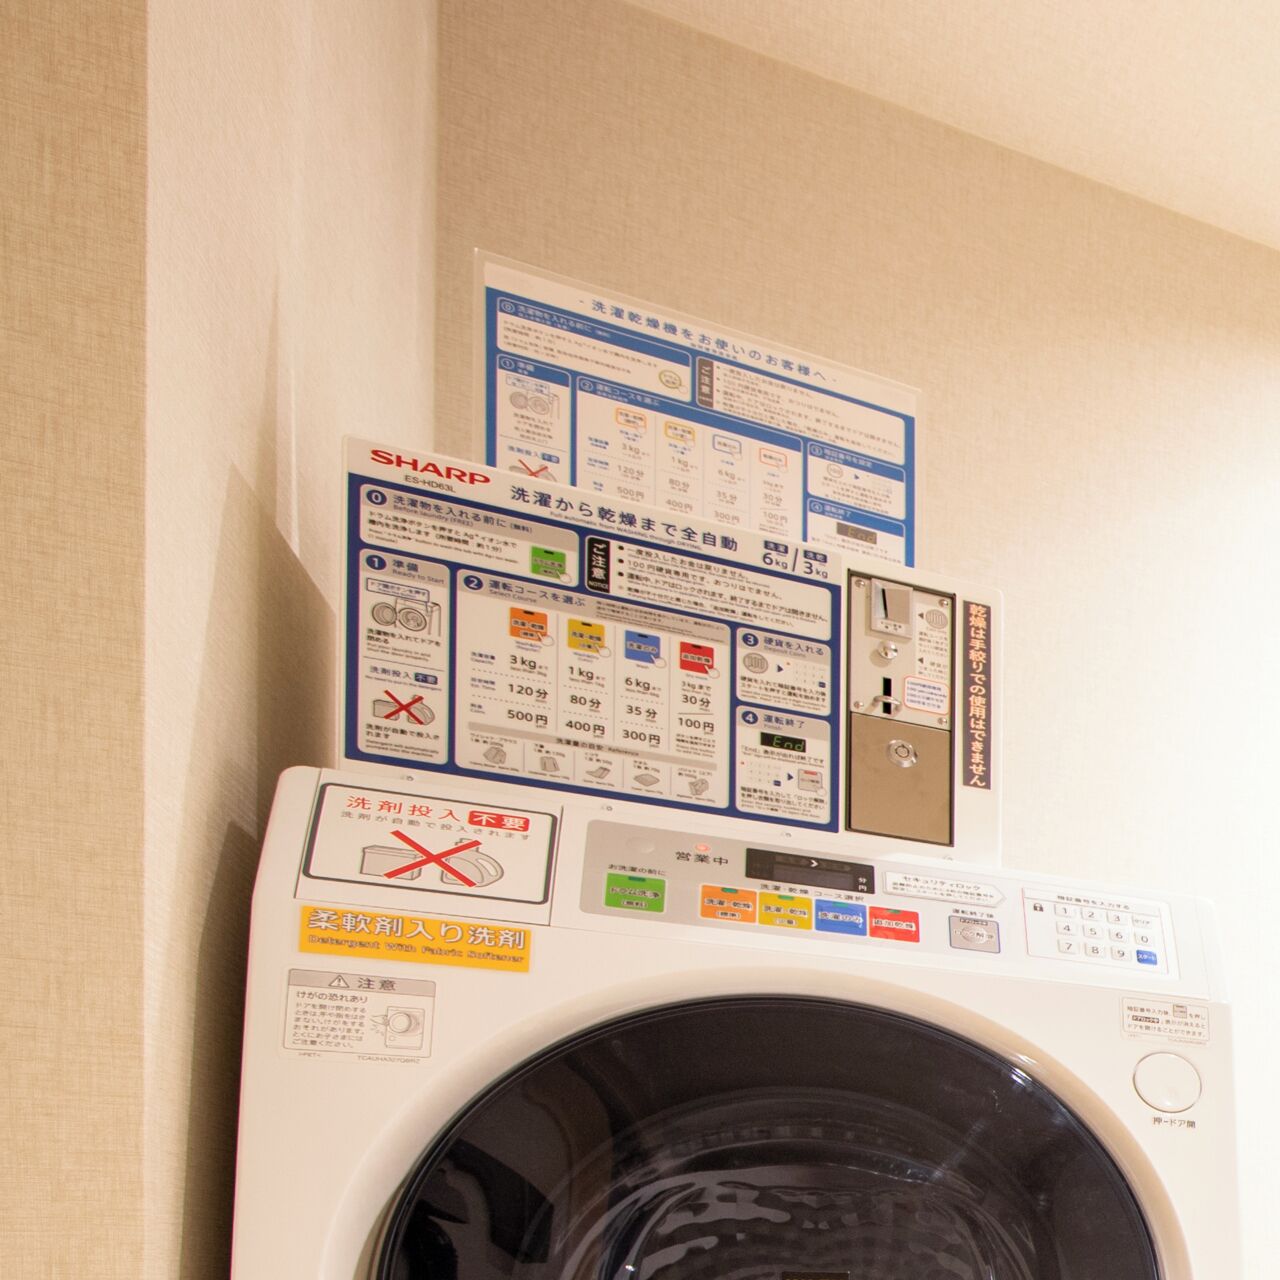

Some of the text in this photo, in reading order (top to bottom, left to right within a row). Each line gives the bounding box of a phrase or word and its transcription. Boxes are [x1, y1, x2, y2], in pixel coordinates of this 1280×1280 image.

[371, 449, 490, 485] SHARP
[393, 494, 507, 528] 洗濯物を入れる前に
[509, 484, 738, 552] 洗濯から乾燥まで全自動
[489, 581, 585, 607] 運転コースを選ぶ
[763, 636, 824, 655] 硬貨を入れる
[507, 710, 548, 726] 500円
[566, 720, 605, 735] 400円
[678, 718, 714, 733] 100円
[764, 714, 804, 729] 運転終了
[623, 730, 660, 745] 300円
[346, 795, 460, 823] 洗剤投入
[340, 811, 531, 841] 洗剤が自動で投入されます
[472, 811, 527, 831] 不要
[675, 851, 729, 867] 営業中
[308, 910, 525, 950] 柔軟剤入り洗剤
[357, 977, 397, 991] 注意
